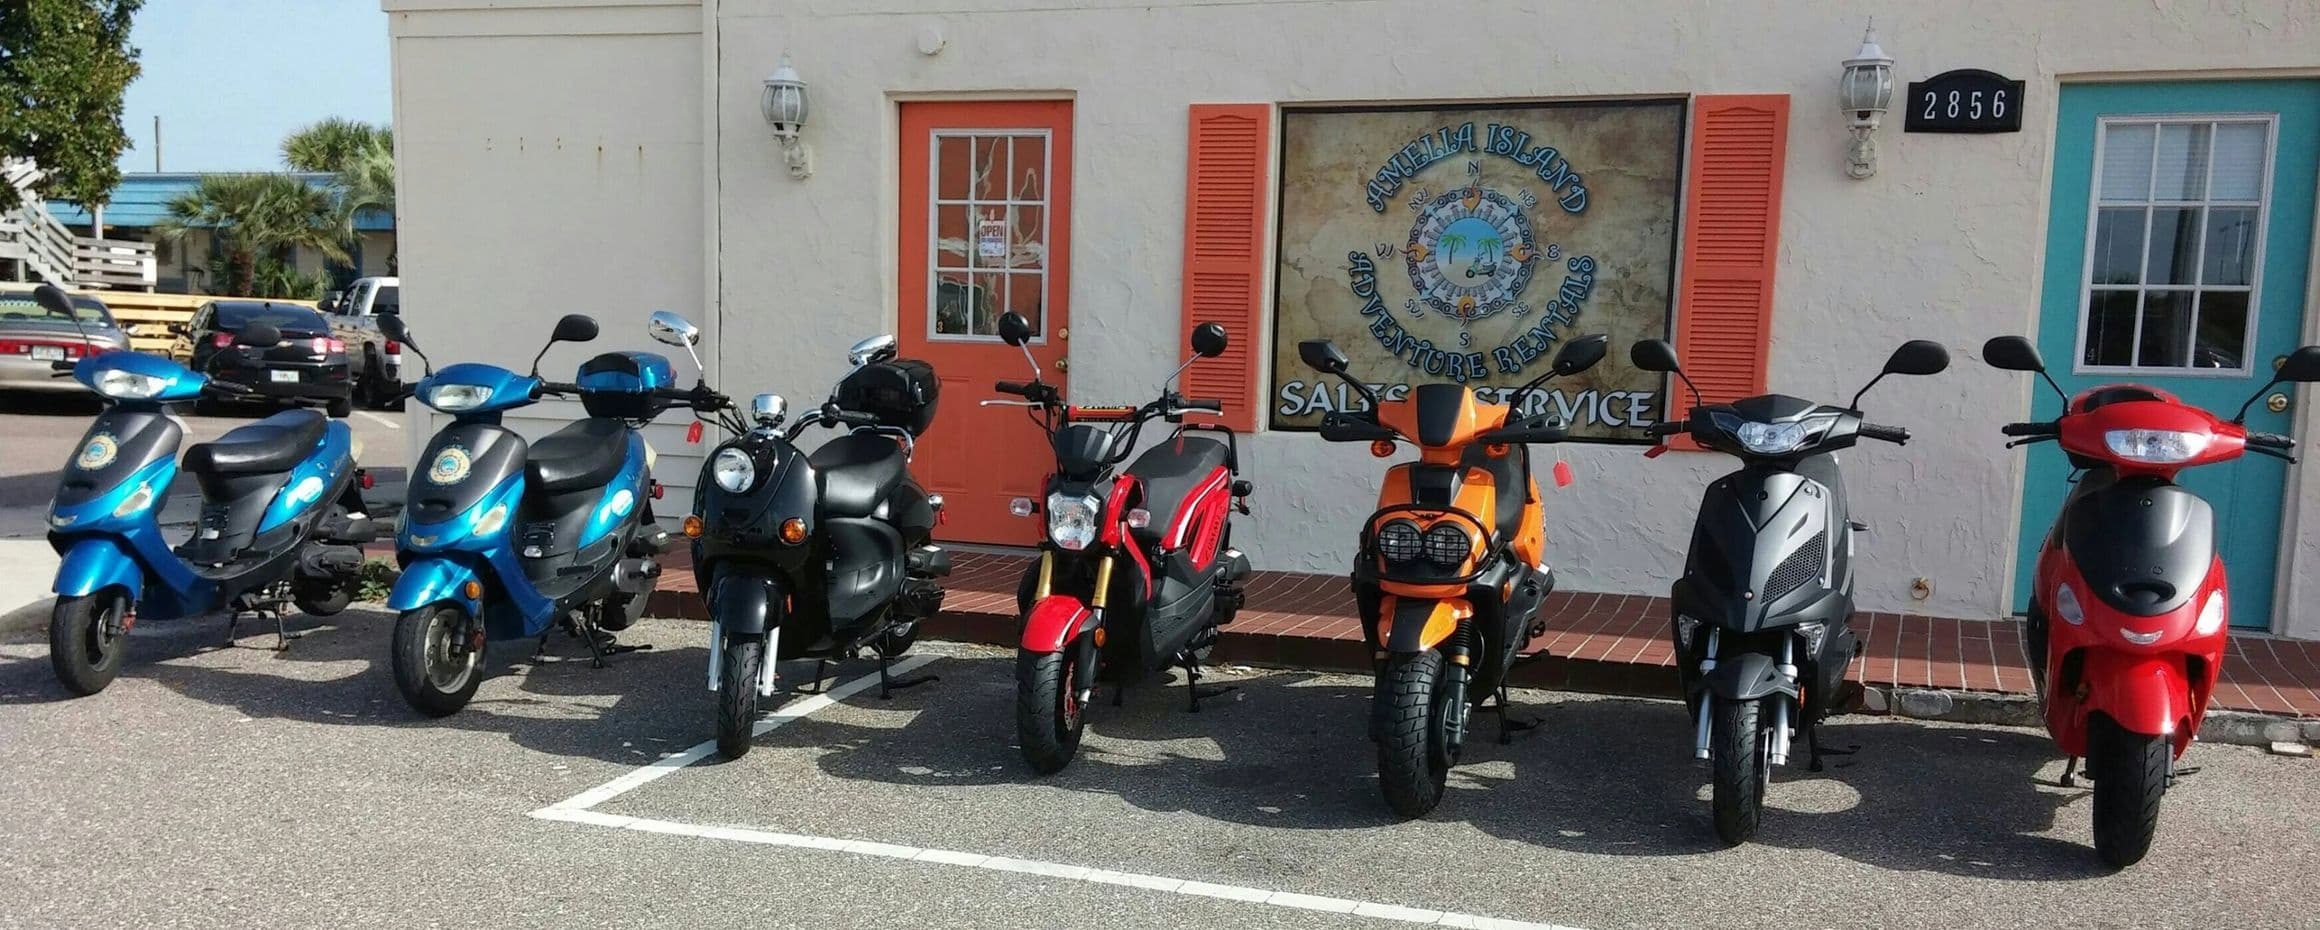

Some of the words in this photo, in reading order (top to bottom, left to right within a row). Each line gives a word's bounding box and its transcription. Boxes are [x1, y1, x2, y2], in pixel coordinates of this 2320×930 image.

[1924, 90, 2006, 120] 2856
[1366, 122, 1477, 212] AMELIA
[1487, 123, 1590, 215] ISLAND
[1467, 160, 1479, 174] N
[981, 225, 1003, 237] OPEN
[1375, 243, 1394, 258] W
[1348, 250, 1487, 381] ADVENTURE
[1494, 255, 1596, 374] RENTALS
[1460, 331, 1470, 347] S
